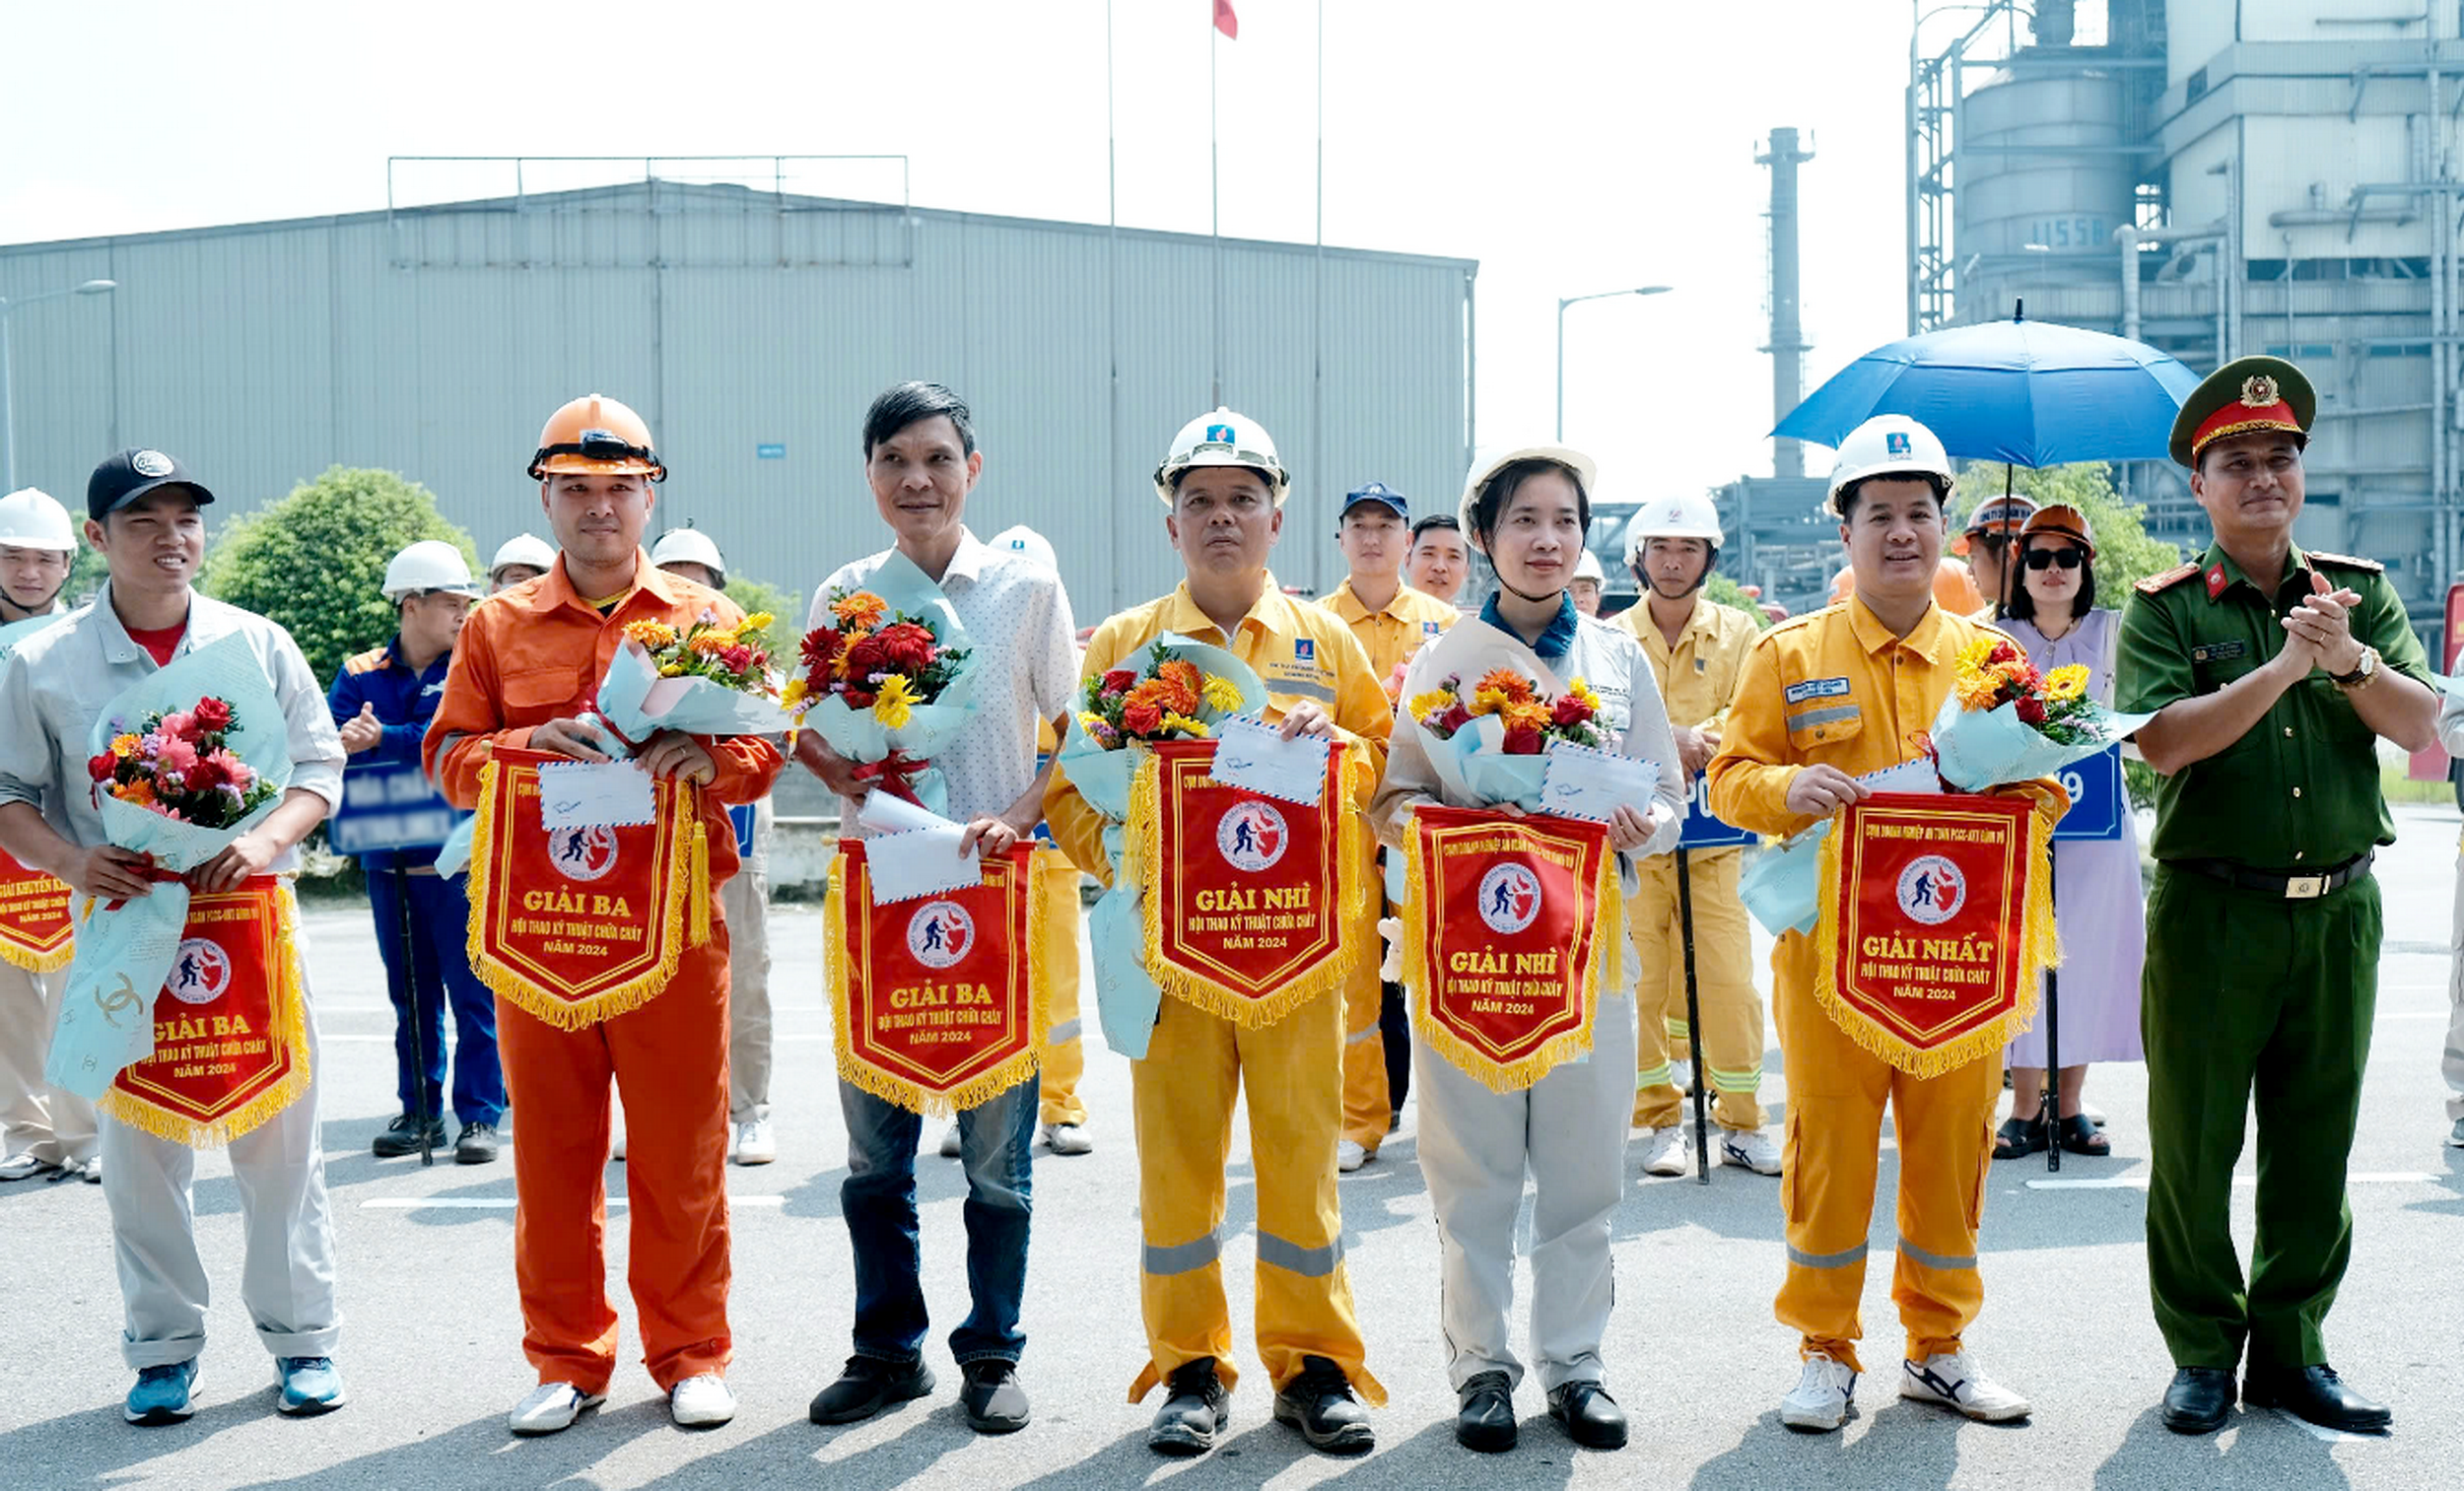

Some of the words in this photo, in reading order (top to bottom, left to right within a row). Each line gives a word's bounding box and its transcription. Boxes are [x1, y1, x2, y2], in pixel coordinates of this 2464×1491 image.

[523, 884, 586, 915] GIẢI
[591, 895, 632, 917] BA
[1196, 881, 1258, 912] GIẢI
[1263, 881, 1311, 910] NHÌ
[528, 919, 551, 935] THAO
[1205, 916, 1228, 931] THAO
[543, 939, 575, 954] NĂM
[578, 943, 608, 956] 2024
[1223, 933, 1255, 949] NĂM
[1258, 937, 1288, 948] 2024
[1863, 929, 1917, 960] GIẢI
[1922, 932, 1995, 963] NHẤT
[1450, 945, 1509, 974] GIẢI
[1515, 946, 1558, 975] NHÌ
[1879, 964, 1900, 979] THAO
[890, 978, 949, 1009] GIẢI
[955, 983, 993, 1004] BA
[1893, 983, 1924, 998] NĂM
[1926, 988, 1956, 1001] 2024
[1472, 998, 1503, 1013] NĂM
[1505, 1003, 1535, 1014] 2024
[212, 1014, 251, 1036] BA
[910, 1030, 938, 1045] NĂM
[940, 1031, 972, 1043] 2024
[173, 1064, 204, 1078] NĂM
[206, 1063, 237, 1076] 2024
